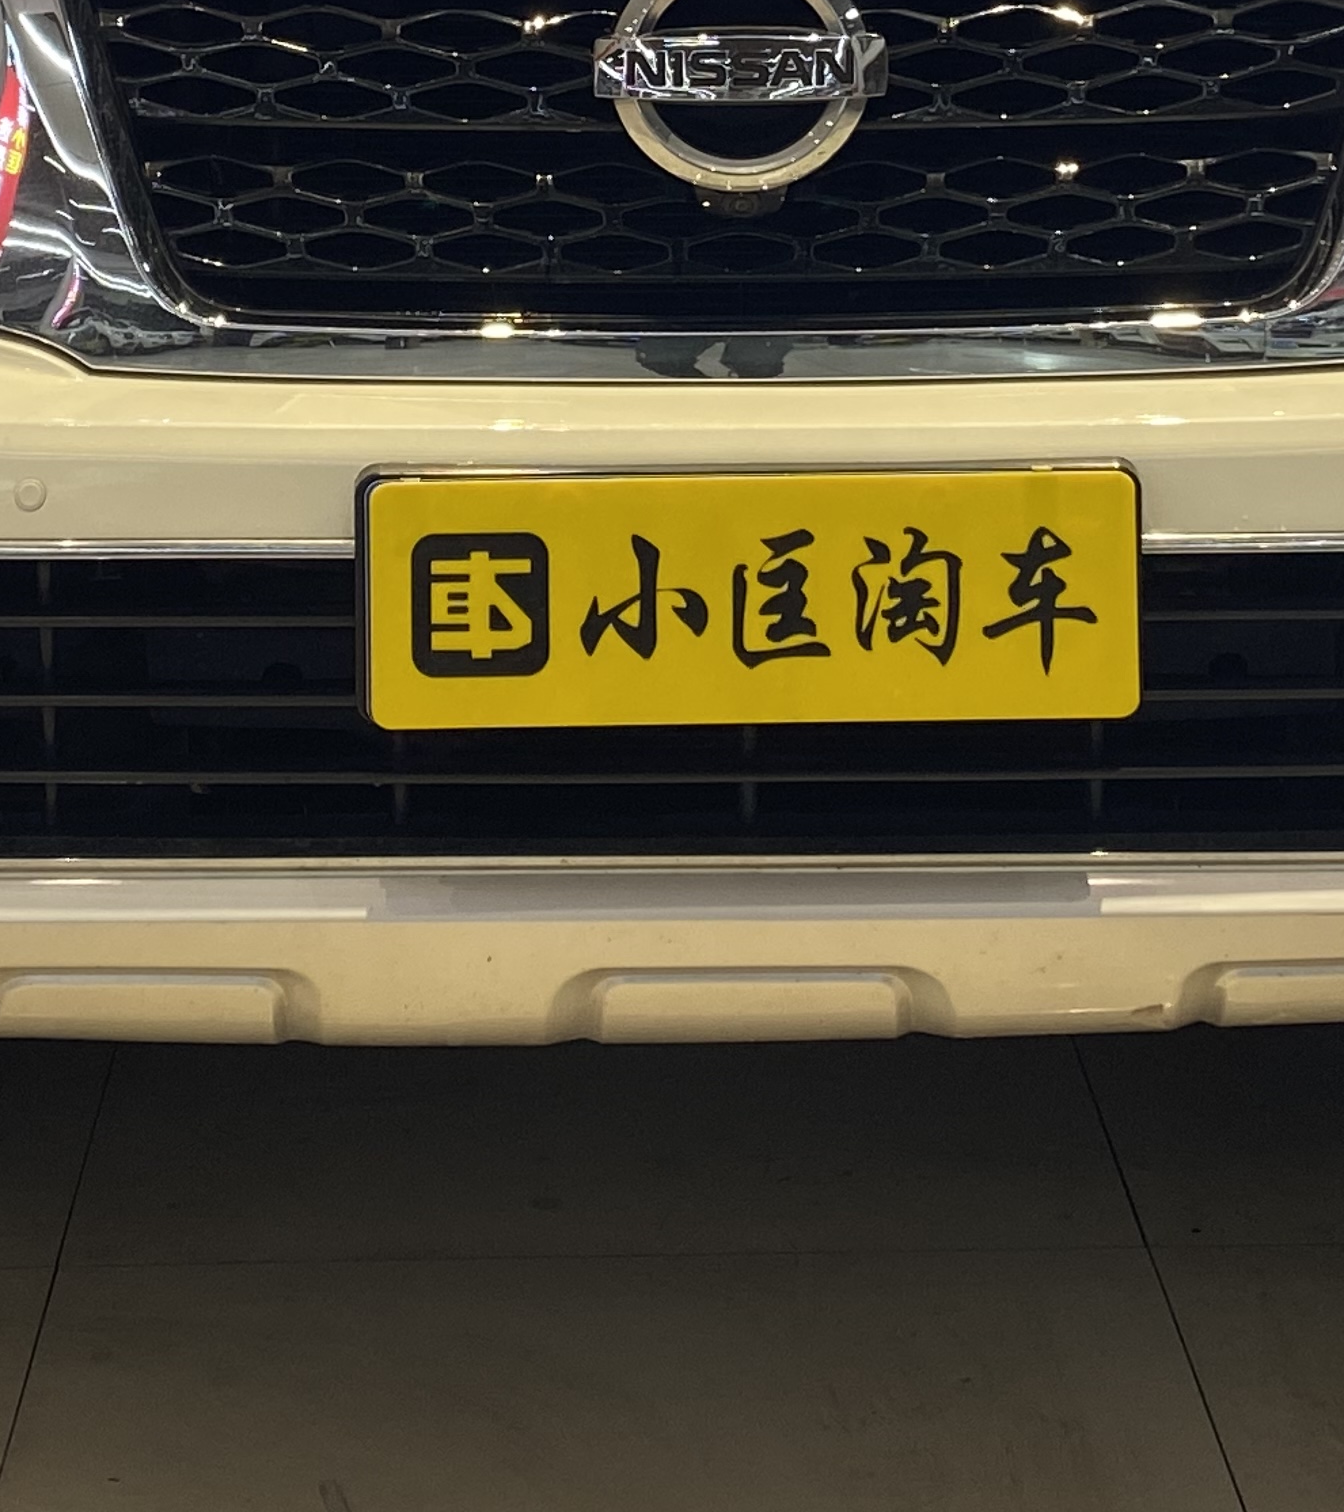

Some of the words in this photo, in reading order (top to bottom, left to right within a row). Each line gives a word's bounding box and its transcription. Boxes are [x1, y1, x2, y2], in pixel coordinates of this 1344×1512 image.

[623, 48, 858, 89] NISSAN
[579, 527, 1098, 676] 小匡淘车
